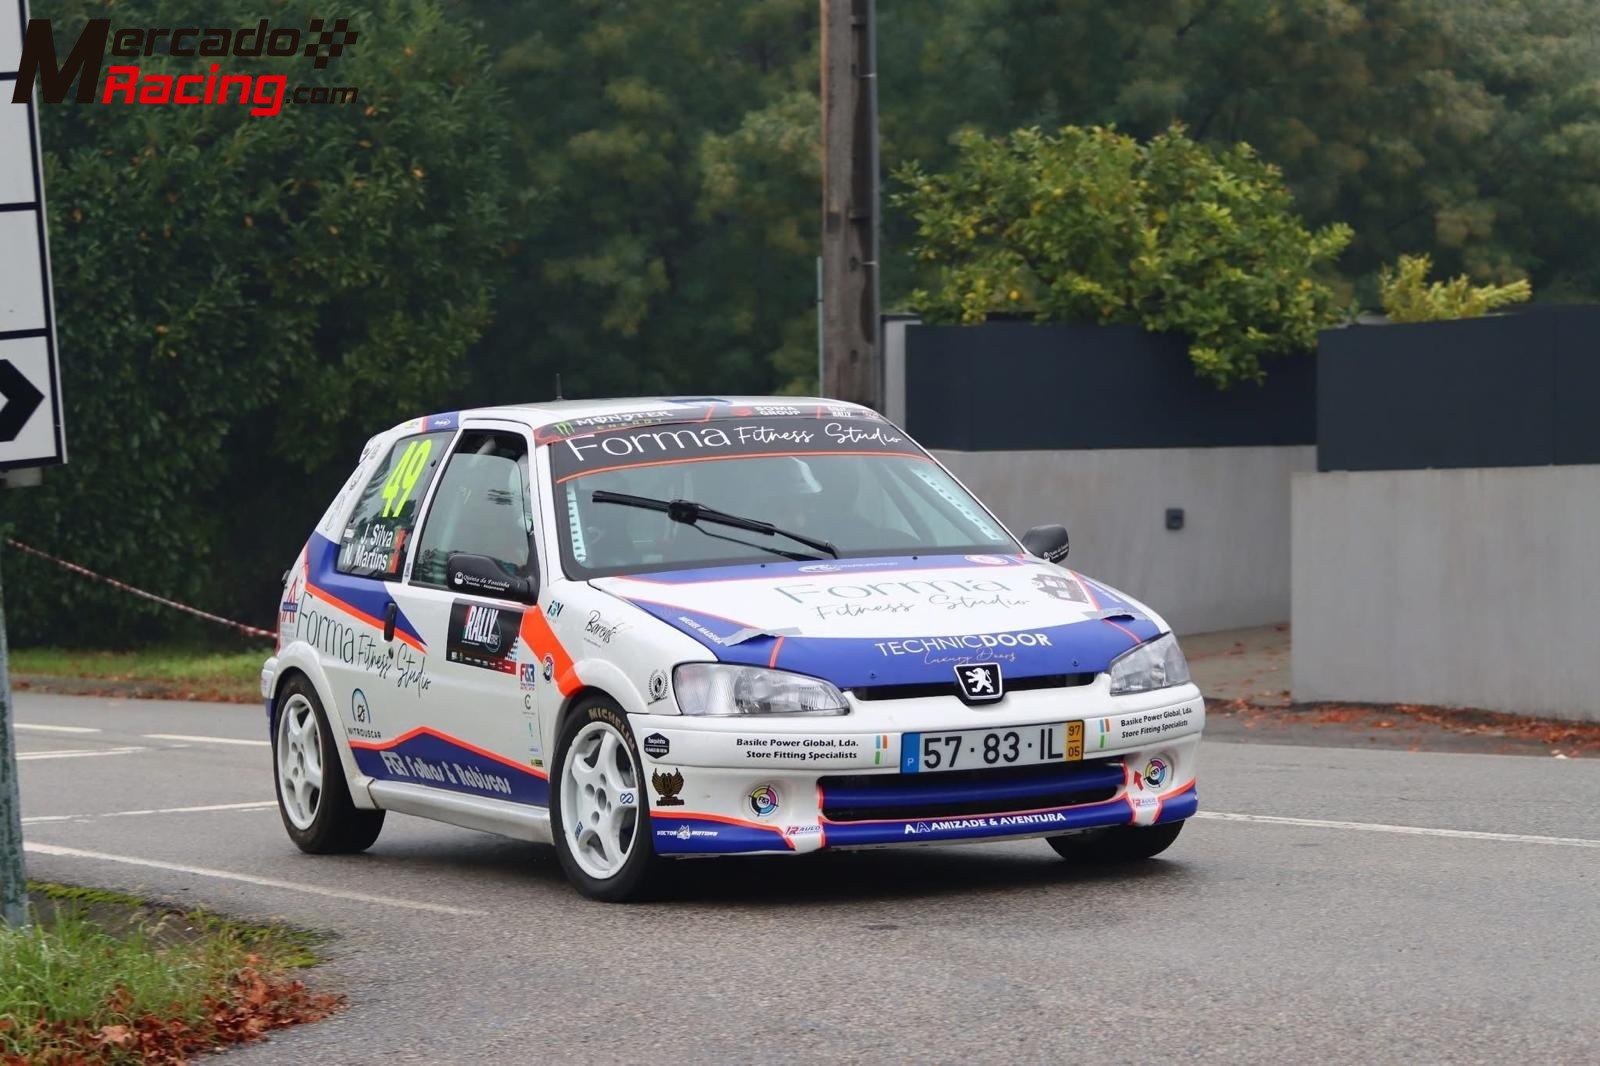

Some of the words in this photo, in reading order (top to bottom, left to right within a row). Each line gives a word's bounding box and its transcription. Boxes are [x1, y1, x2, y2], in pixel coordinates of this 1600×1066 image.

[566, 428, 731, 462] Forma
[734, 426, 814, 444] Fitness
[824, 423, 901, 446] Studio
[382, 439, 432, 517] 49
[370, 523, 393, 548] Silva
[353, 545, 388, 571] Martins
[774, 580, 1011, 603] Forma
[816, 602, 915, 620] Fitness
[928, 594, 1030, 610] Studio
[464, 605, 499, 643] RALLY
[296, 591, 355, 665] Forma
[357, 634, 392, 680] Fitness
[397, 643, 432, 698] Studio
[874, 633, 1053, 657] TECHNICDOOR
[1068, 725, 1081, 737] 97
[1120, 718, 1143, 727] Basike
[1143, 713, 1162, 724] Power
[1121, 729, 1140, 739] Store
[1140, 724, 1161, 735] Fitting
[1161, 720, 1189, 731] Specialists
[736, 738, 768, 747] Basike
[770, 738, 800, 747] Power
[802, 739, 837, 748] Global,
[839, 739, 859, 747] Lda.
[1068, 746, 1081, 757] 05
[746, 750, 772, 758] Store
[773, 750, 806, 761] Fitting
[808, 751, 858, 761] Specialists
[907, 758, 914, 767] P
[931, 820, 987, 831] AMIZADE
[989, 818, 997, 826] &
[1000, 812, 1066, 826] AVENTURA
